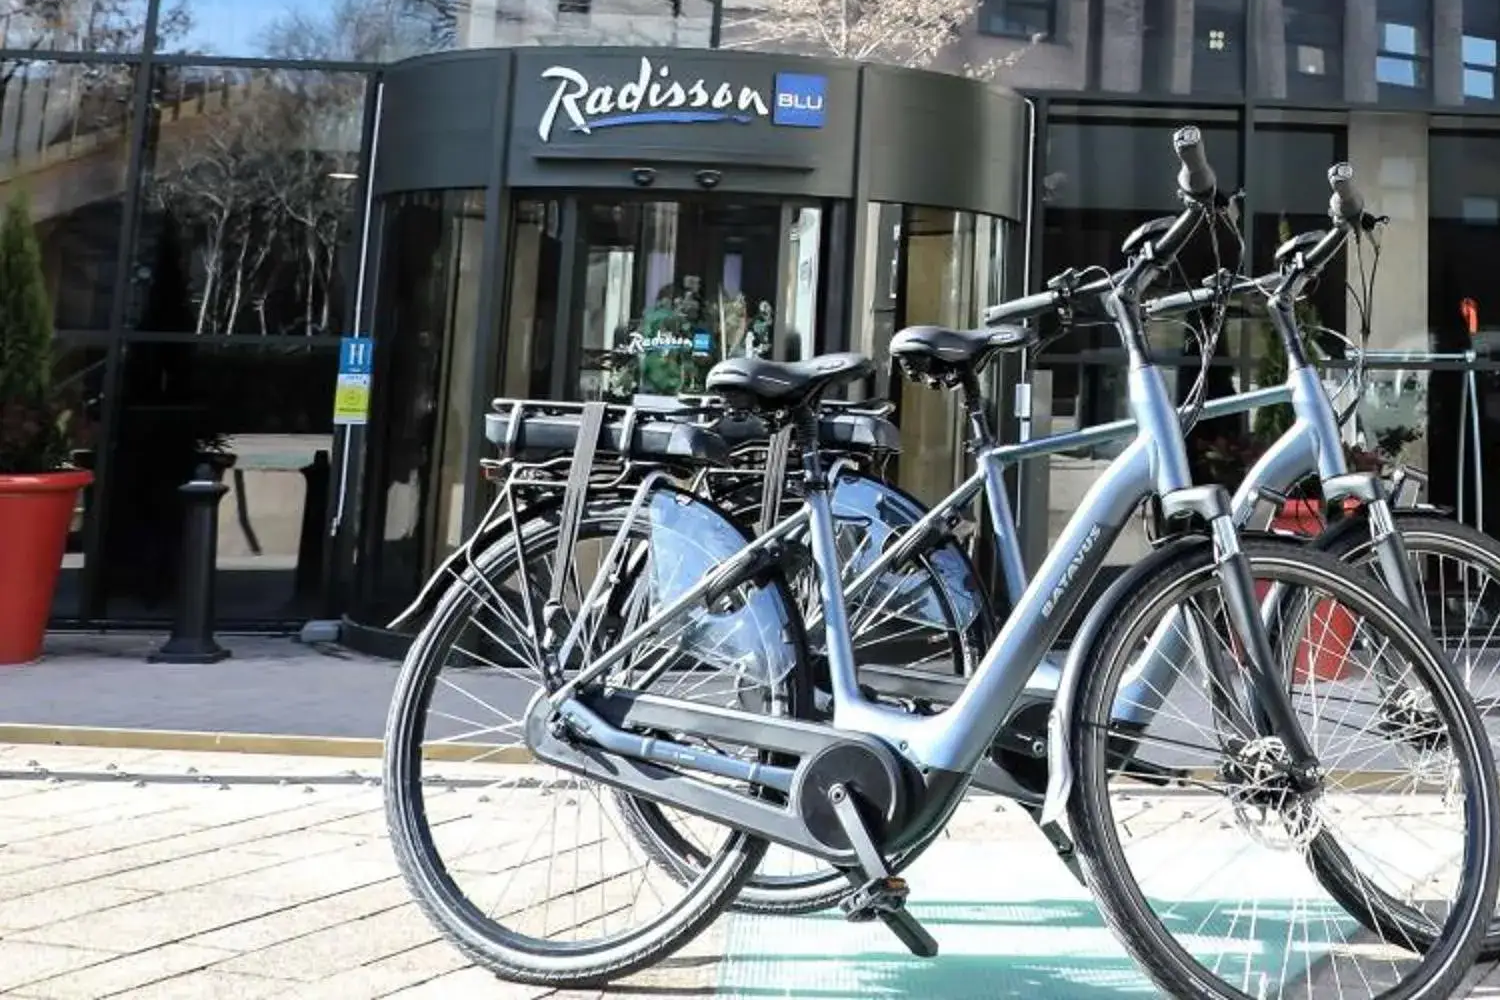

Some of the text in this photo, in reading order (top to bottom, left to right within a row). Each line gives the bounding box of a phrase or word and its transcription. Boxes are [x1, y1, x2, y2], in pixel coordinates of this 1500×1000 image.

[538, 56, 823, 142] Radisson BLU
[349, 343, 365, 365] H
[1042, 524, 1101, 618] BATAVUS
